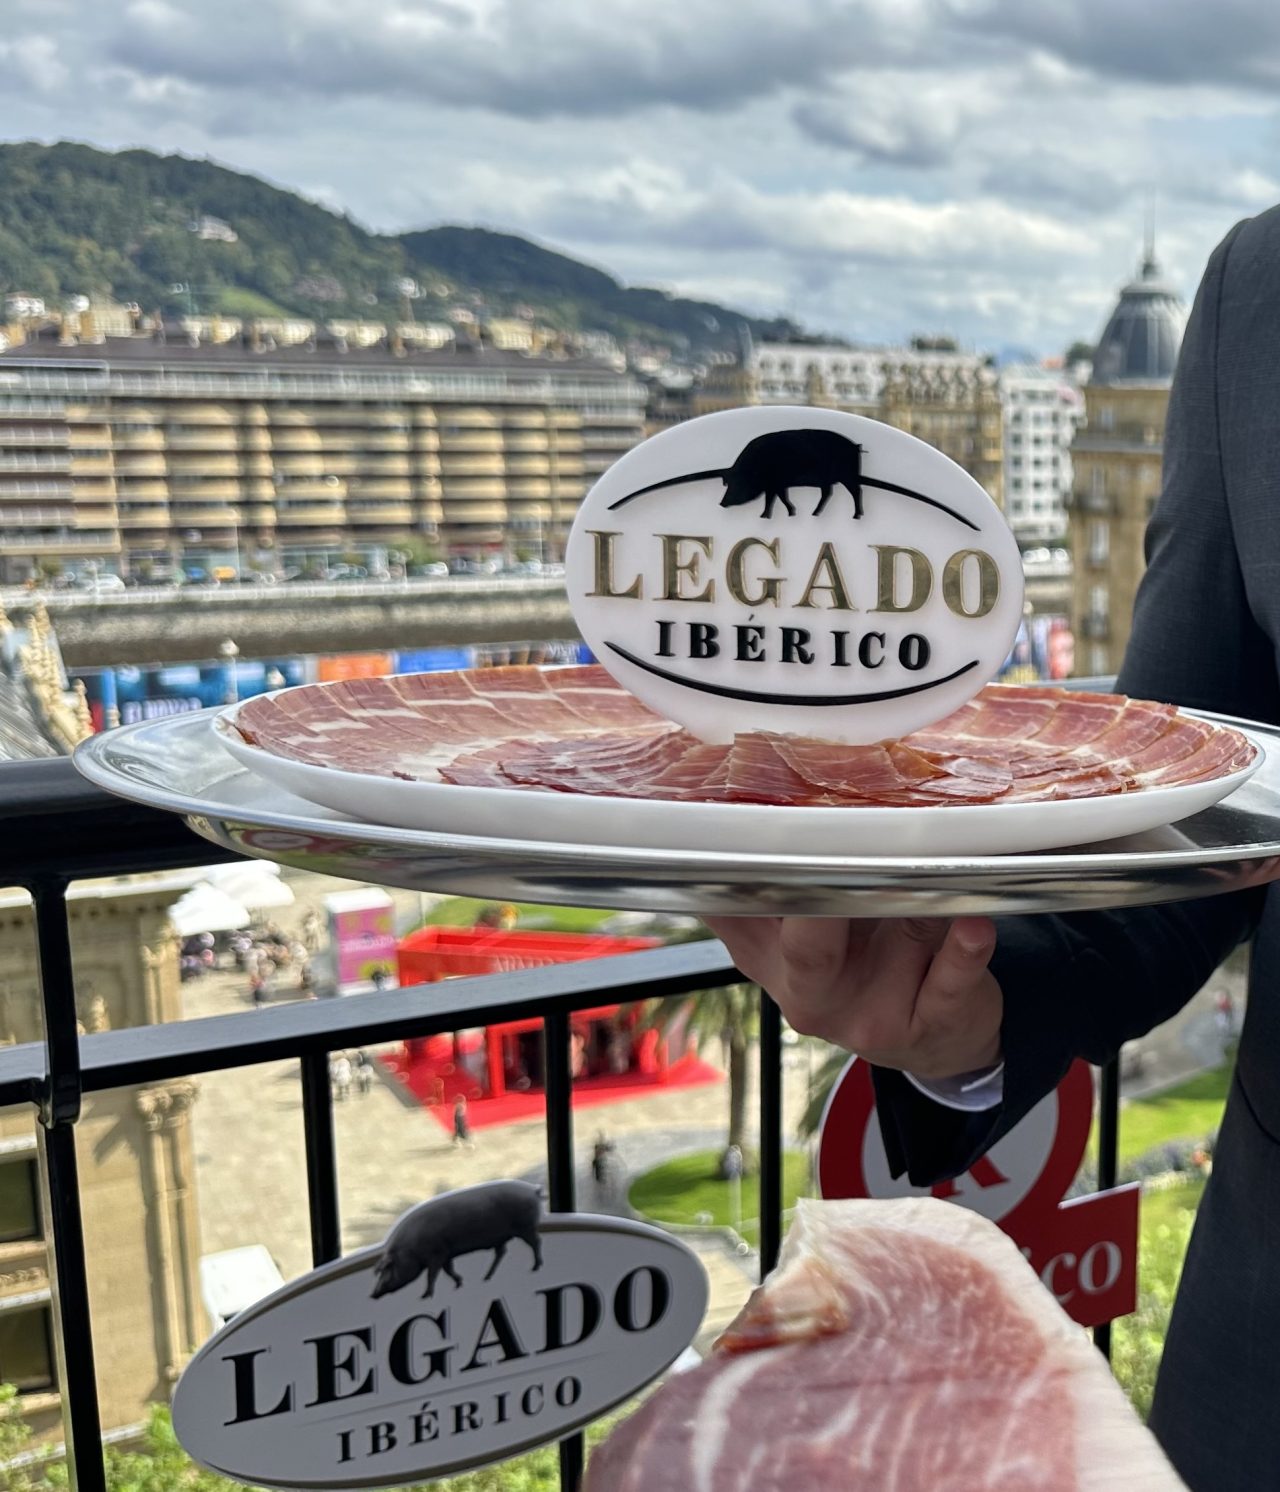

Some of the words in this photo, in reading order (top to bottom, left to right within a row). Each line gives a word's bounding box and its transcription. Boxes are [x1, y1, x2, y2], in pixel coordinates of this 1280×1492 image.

[584, 529, 1001, 619] LEGADO
[654, 614, 931, 671] IBÉRICO
[222, 1265, 672, 1426] LEGADO
[336, 1375, 583, 1464] IBÉRICO
